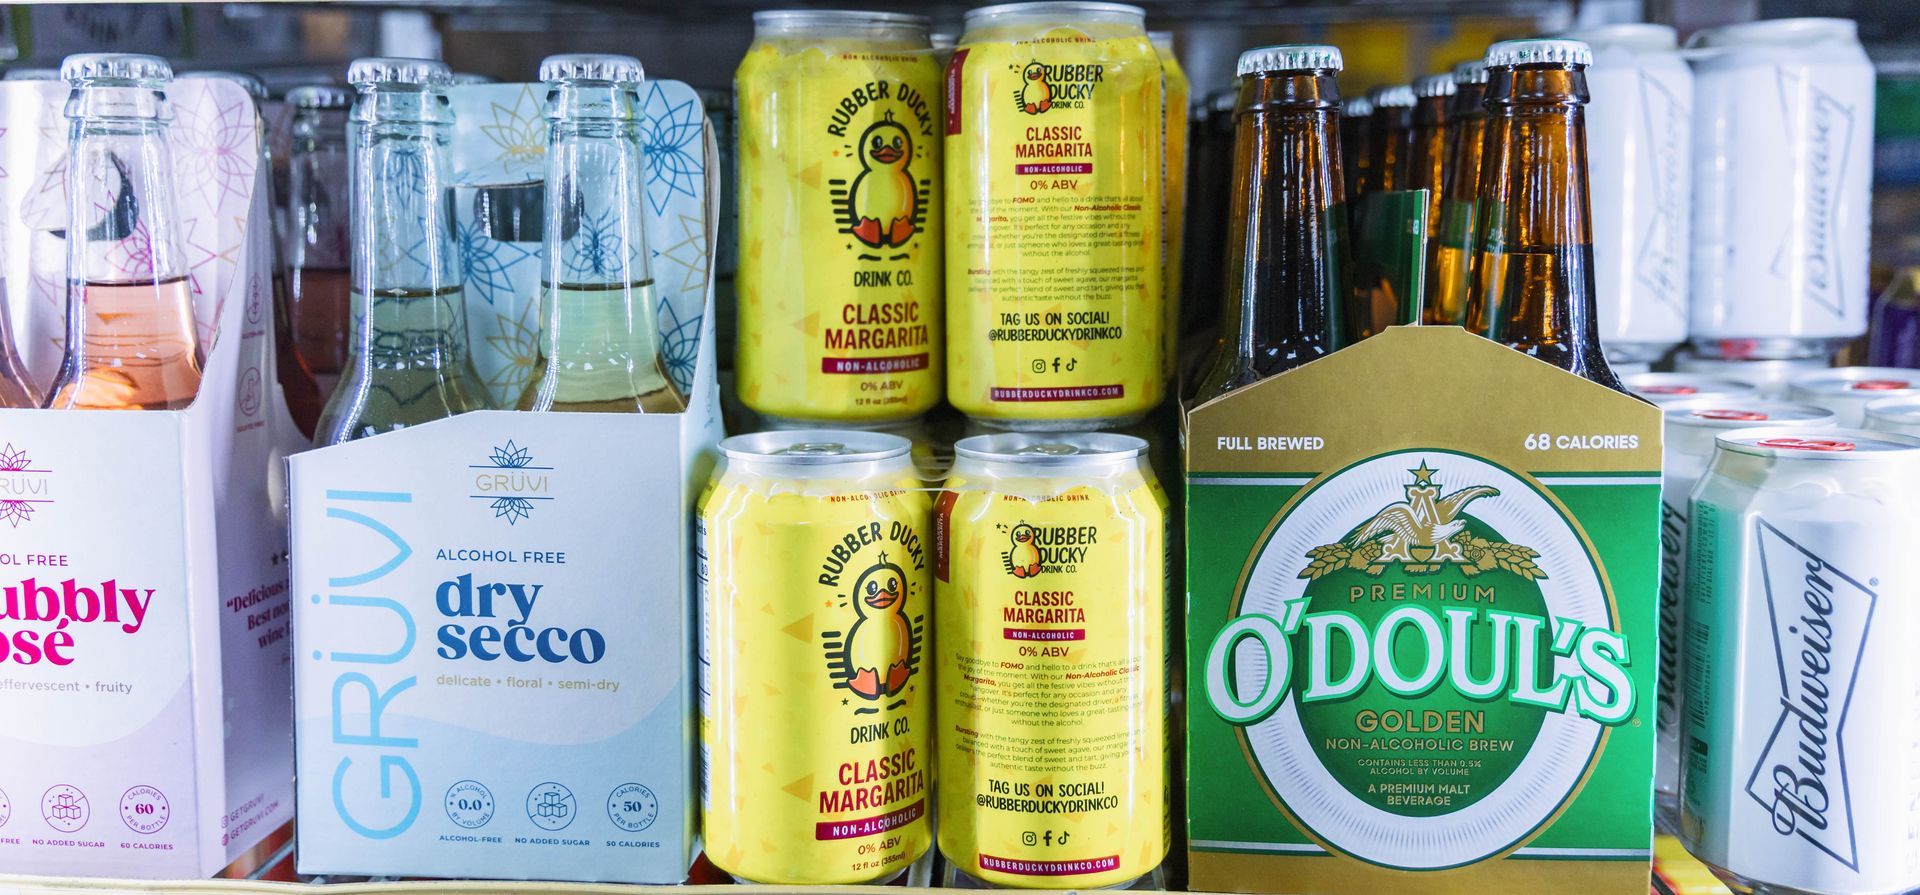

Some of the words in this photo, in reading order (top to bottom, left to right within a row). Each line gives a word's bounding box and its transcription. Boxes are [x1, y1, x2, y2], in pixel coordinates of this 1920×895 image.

[1043, 64, 1103, 82] RUBBER
[1050, 84, 1095, 100] DUCKY
[827, 80, 890, 138] RUBBER
[897, 82, 934, 137] DUCKY
[1051, 101, 1072, 109] DRINK
[1074, 101, 1085, 109] CO.
[1026, 126, 1082, 141] CLASSIC
[1015, 143, 1093, 158] MARGARITA
[1024, 165, 1083, 173] NON-ALCOHOLIC
[1030, 180, 1048, 190] 0%
[1051, 179, 1078, 190] ABV
[854, 271, 892, 287] DRINK
[896, 270, 913, 286] CO.
[842, 301, 919, 325] CLASSIC
[1000, 313, 1021, 326] TAG
[1025, 313, 1040, 325] US
[1045, 312, 1062, 325] ON
[1067, 311, 1110, 325] SOCIAL!
[825, 325, 929, 349] MARGARITA
[988, 326, 1122, 341] @RUBBERDUCKYDRINKCO
[836, 358, 920, 372] NON-ALCOHOLIC
[860, 382, 878, 391] 0%
[880, 380, 904, 391] ABV
[994, 387, 1119, 399] RUBBERDUCKYDRINKCO.COM
[1217, 436, 1252, 450] FULL
[1257, 436, 1324, 450] BREWED
[1524, 434, 1551, 450] 68
[1556, 435, 1638, 450] CALORIES
[0, 474, 48, 495] RÜVI
[475, 471, 548, 493] GRÜVI
[1033, 526, 1097, 545] RUBBER
[27, 554, 68, 566] FREE
[436, 548, 517, 563] ALCOHOL
[523, 551, 566, 564] FREE
[818, 521, 883, 586] RUBBER
[889, 520, 925, 572] DUCKY
[1040, 547, 1088, 564] DUCKY
[1041, 565, 1063, 574] DRINK
[1065, 565, 1077, 574] CO.
[435, 572, 544, 628] dry
[1014, 590, 1074, 606] CLASSIC
[1349, 583, 1495, 603] PREMIUM
[0, 577, 156, 634] ubbly
[247, 608, 271, 630] Best
[1003, 607, 1085, 624] MARGARITA
[0, 618, 75, 666] sé
[1012, 630, 1075, 639] NON-ALCOHOLIC
[436, 624, 606, 665] secco
[1018, 646, 1038, 657] 0%
[1041, 646, 1069, 657] ABV
[311, 489, 422, 840] GRÜVI
[1000, 661, 1024, 670] FOMO
[1203, 597, 1641, 726] O'DOUL'S
[1065, 668, 1117, 680] Non-Alcoholic
[95, 680, 133, 695] fruity
[436, 673, 491, 687] delicate
[506, 675, 543, 689] floral
[558, 677, 620, 692] semi-dry
[963, 674, 997, 687] Margarita,
[1036, 682, 1049, 690] the
[1013, 691, 1040, 699] perfect
[1041, 691, 1051, 699] for
[1053, 692, 1067, 700] any
[1772, 549, 1840, 836] Budweiser
[1034, 700, 1047, 708] the
[1048, 700, 1091, 709] designated
[1006, 709, 1041, 717] someone
[1041, 709, 1059, 717] who
[1060, 709, 1079, 717] loves
[1041, 719, 1055, 727] the
[1355, 709, 1485, 734] GOLDEN
[850, 721, 890, 745] DRINK
[893, 716, 910, 734] CO.
[1325, 738, 1463, 751] NON-ALCOHOLIC
[1469, 739, 1514, 751] BREW
[838, 747, 916, 786] CLASSIC
[1357, 758, 1406, 767] CONTAINS
[1408, 759, 1430, 767] LESS
[1432, 759, 1457, 767] THAN
[1459, 760, 1482, 768] 0.5%
[1369, 767, 1414, 775] ALCOHOL
[1417, 767, 1429, 775] BY
[1432, 767, 1469, 776] VOLUME
[127, 788, 162, 801] CALORIES
[456, 784, 488, 799] ALCOHOL
[616, 786, 650, 799] CALORIES
[819, 768, 924, 814] MARGARITA
[988, 779, 1010, 794] TAG
[1014, 783, 1029, 796] US
[1035, 784, 1054, 797] ON
[1058, 781, 1105, 797] SOCIAL!
[1367, 784, 1376, 793] A
[1380, 784, 1435, 794] PREMIUM
[1438, 784, 1471, 795] MALT
[458, 799, 482, 811] 0.0
[623, 801, 642, 812] 50
[976, 793, 1118, 814] @RUBBERDUCKYDRINKCO
[1387, 795, 1451, 806] BEVERAGE
[135, 803, 154, 815] 60
[126, 815, 139, 828] PER
[140, 814, 166, 831] BOTTLE
[451, 812, 461, 820] BY
[462, 813, 490, 826] VOLUME
[614, 813, 626, 826] PER
[628, 812, 654, 829] BOTTLE
[833, 807, 917, 836] NON-ALCOHOLIC
[439, 835, 503, 843] ALCOHOL-FREE
[858, 843, 876, 855] 0%
[879, 835, 902, 851] ABV
[851, 862, 861, 871] 12
[983, 857, 1115, 872] RUBBERDUCKYDRINKCO.COM
